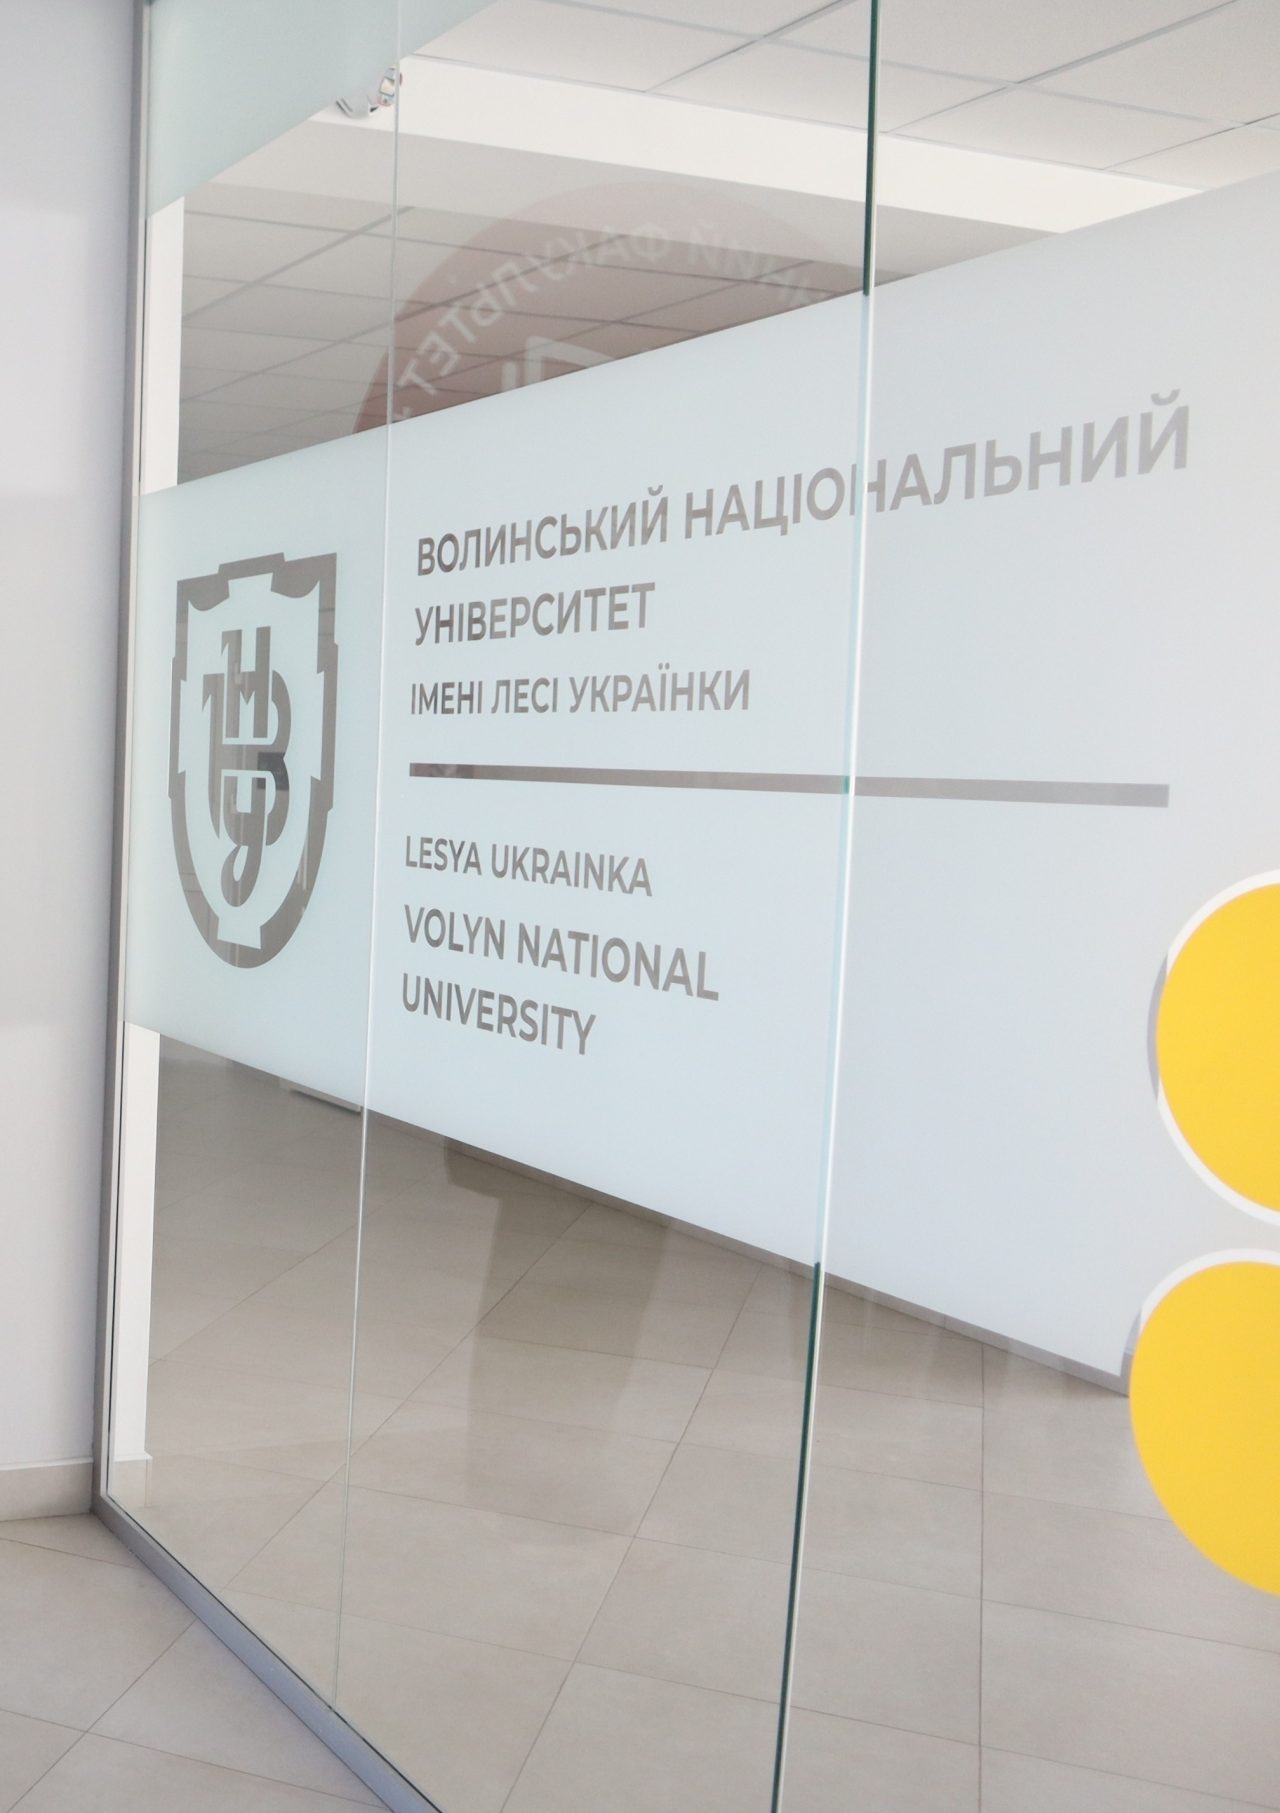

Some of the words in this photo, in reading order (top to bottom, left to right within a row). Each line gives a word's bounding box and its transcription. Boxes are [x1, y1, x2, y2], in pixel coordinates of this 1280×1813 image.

[416, 484, 668, 577] ВОЛИНСЬКИЙ
[683, 389, 1191, 538] НАЦІОНАЛЬНИЙ
[414, 582, 656, 646] УНІВЕРСИТЕТ
[410, 680, 483, 716] ІМЕНІ
[491, 678, 559, 715] ЛЕСІ
[568, 663, 752, 714] УКРАЇНКИ
[404, 834, 483, 876] LESYA
[490, 843, 653, 897] UKRAINKA
[404, 904, 506, 960] VOLYN
[517, 922, 721, 1001] NATIONAL
[401, 972, 597, 1056] UNIVERSITY
